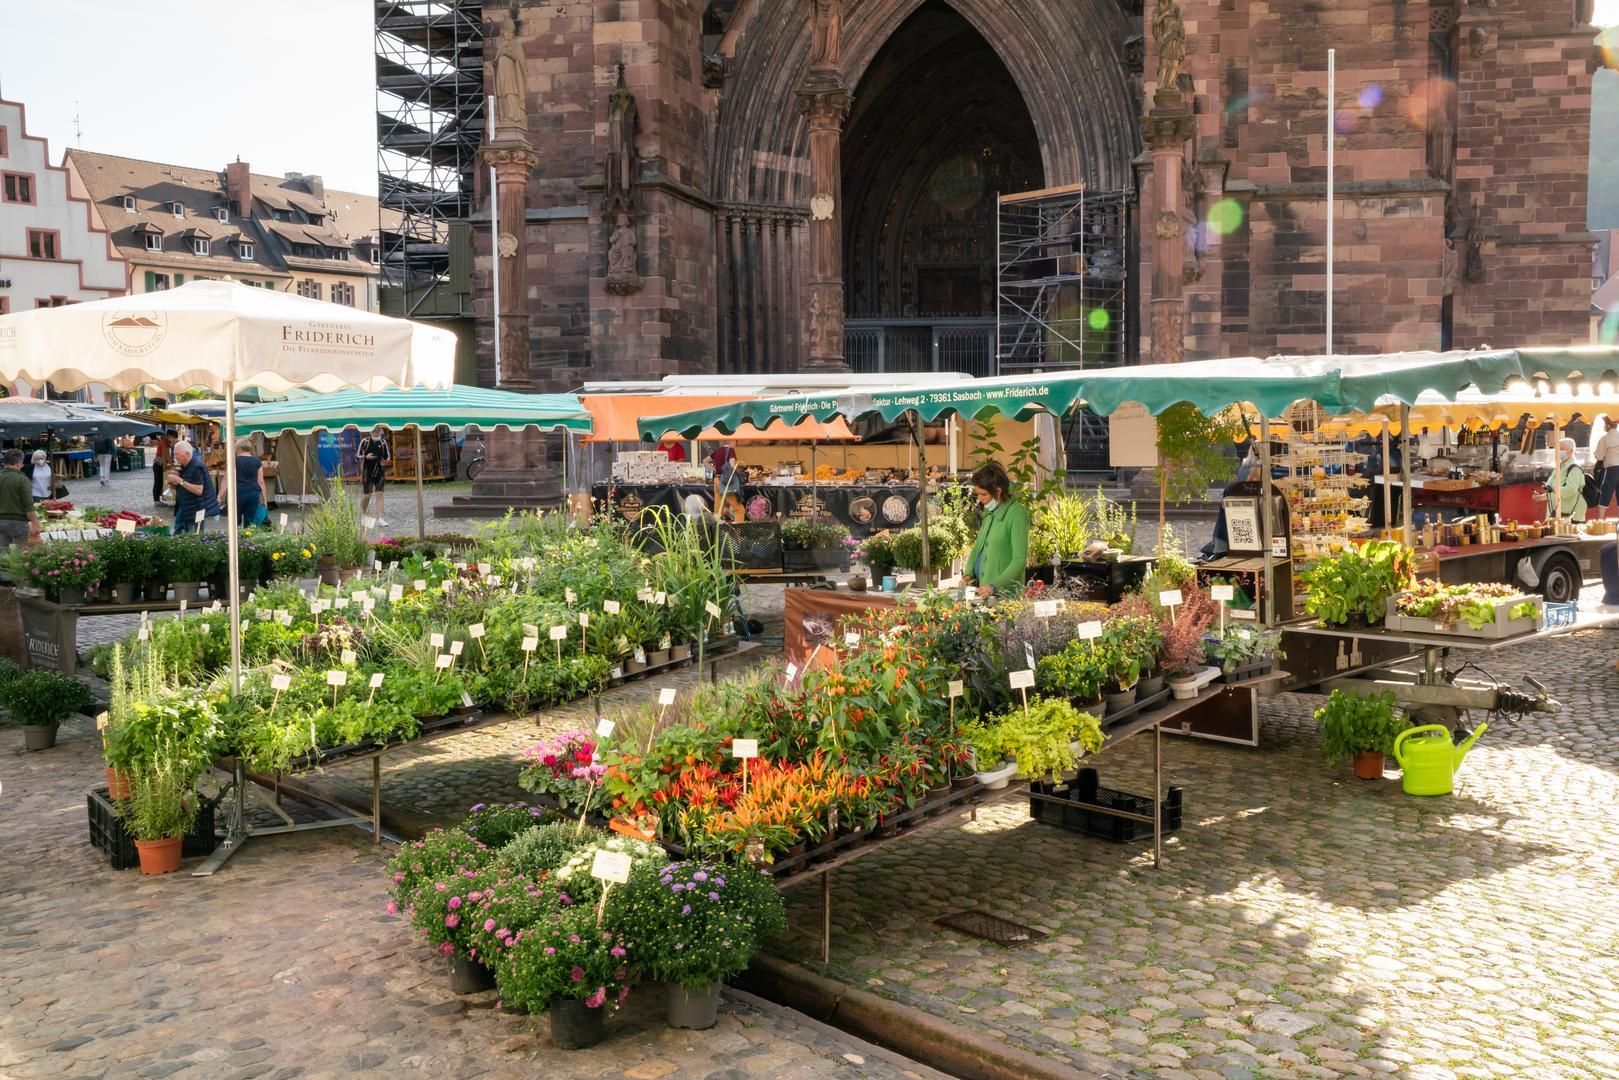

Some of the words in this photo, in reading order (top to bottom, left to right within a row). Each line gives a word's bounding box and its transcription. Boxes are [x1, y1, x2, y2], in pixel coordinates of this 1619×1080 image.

[282, 325, 375, 346] FRIDERICH
[769, 403, 794, 413] Gärtnerei
[821, 400, 831, 410] Die
[894, 396, 920, 406] Lehweg
[920, 395, 926, 404] 2
[929, 393, 952, 403] 79361
[953, 391, 982, 401] Sasbach
[986, 386, 1049, 399] www.Friderich.de
